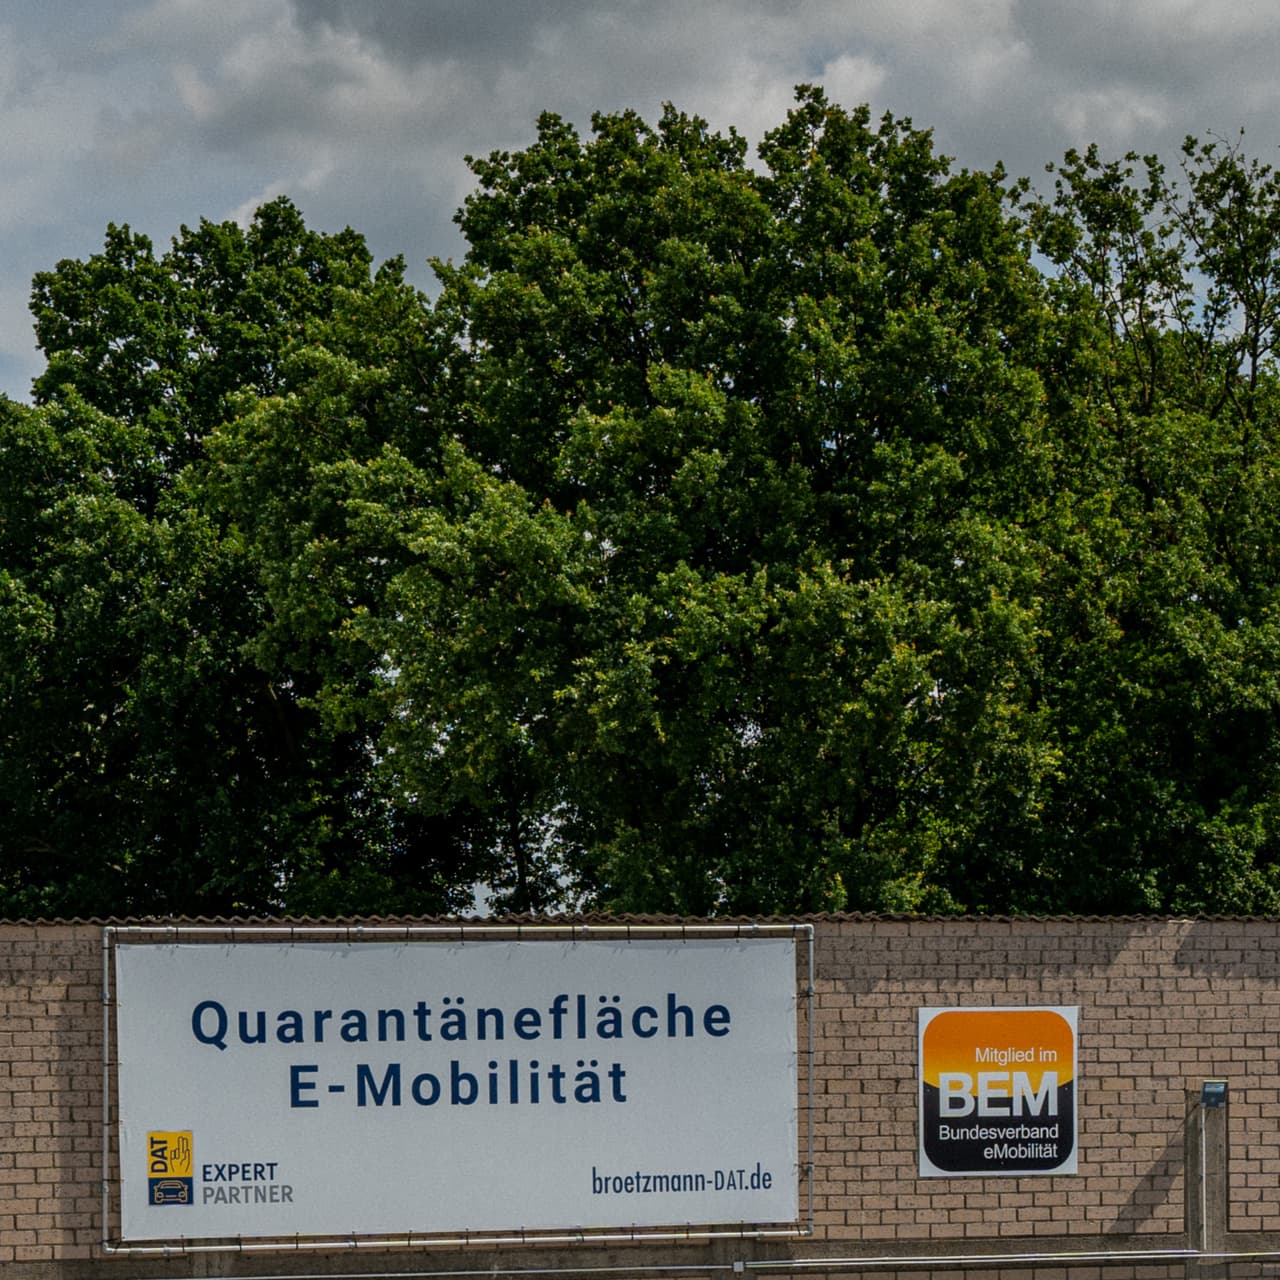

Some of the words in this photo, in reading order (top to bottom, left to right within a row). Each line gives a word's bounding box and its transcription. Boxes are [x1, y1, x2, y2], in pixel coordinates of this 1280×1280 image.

[190, 992, 732, 1051] Quarantänefläche
[975, 1047, 1035, 1066] Mitglied
[1039, 1047, 1057, 1062] im
[289, 1060, 628, 1109] E-Mobilität
[938, 1071, 1059, 1118] BEM
[938, 1124, 1059, 1141] Bundesverband
[150, 1136, 168, 1173] DAT
[983, 1143, 1058, 1159] eMobilität
[202, 1163, 278, 1182] EXPERT
[592, 1161, 773, 1195] broetzmann-DAT.de
[202, 1185, 294, 1205] PARTNER
